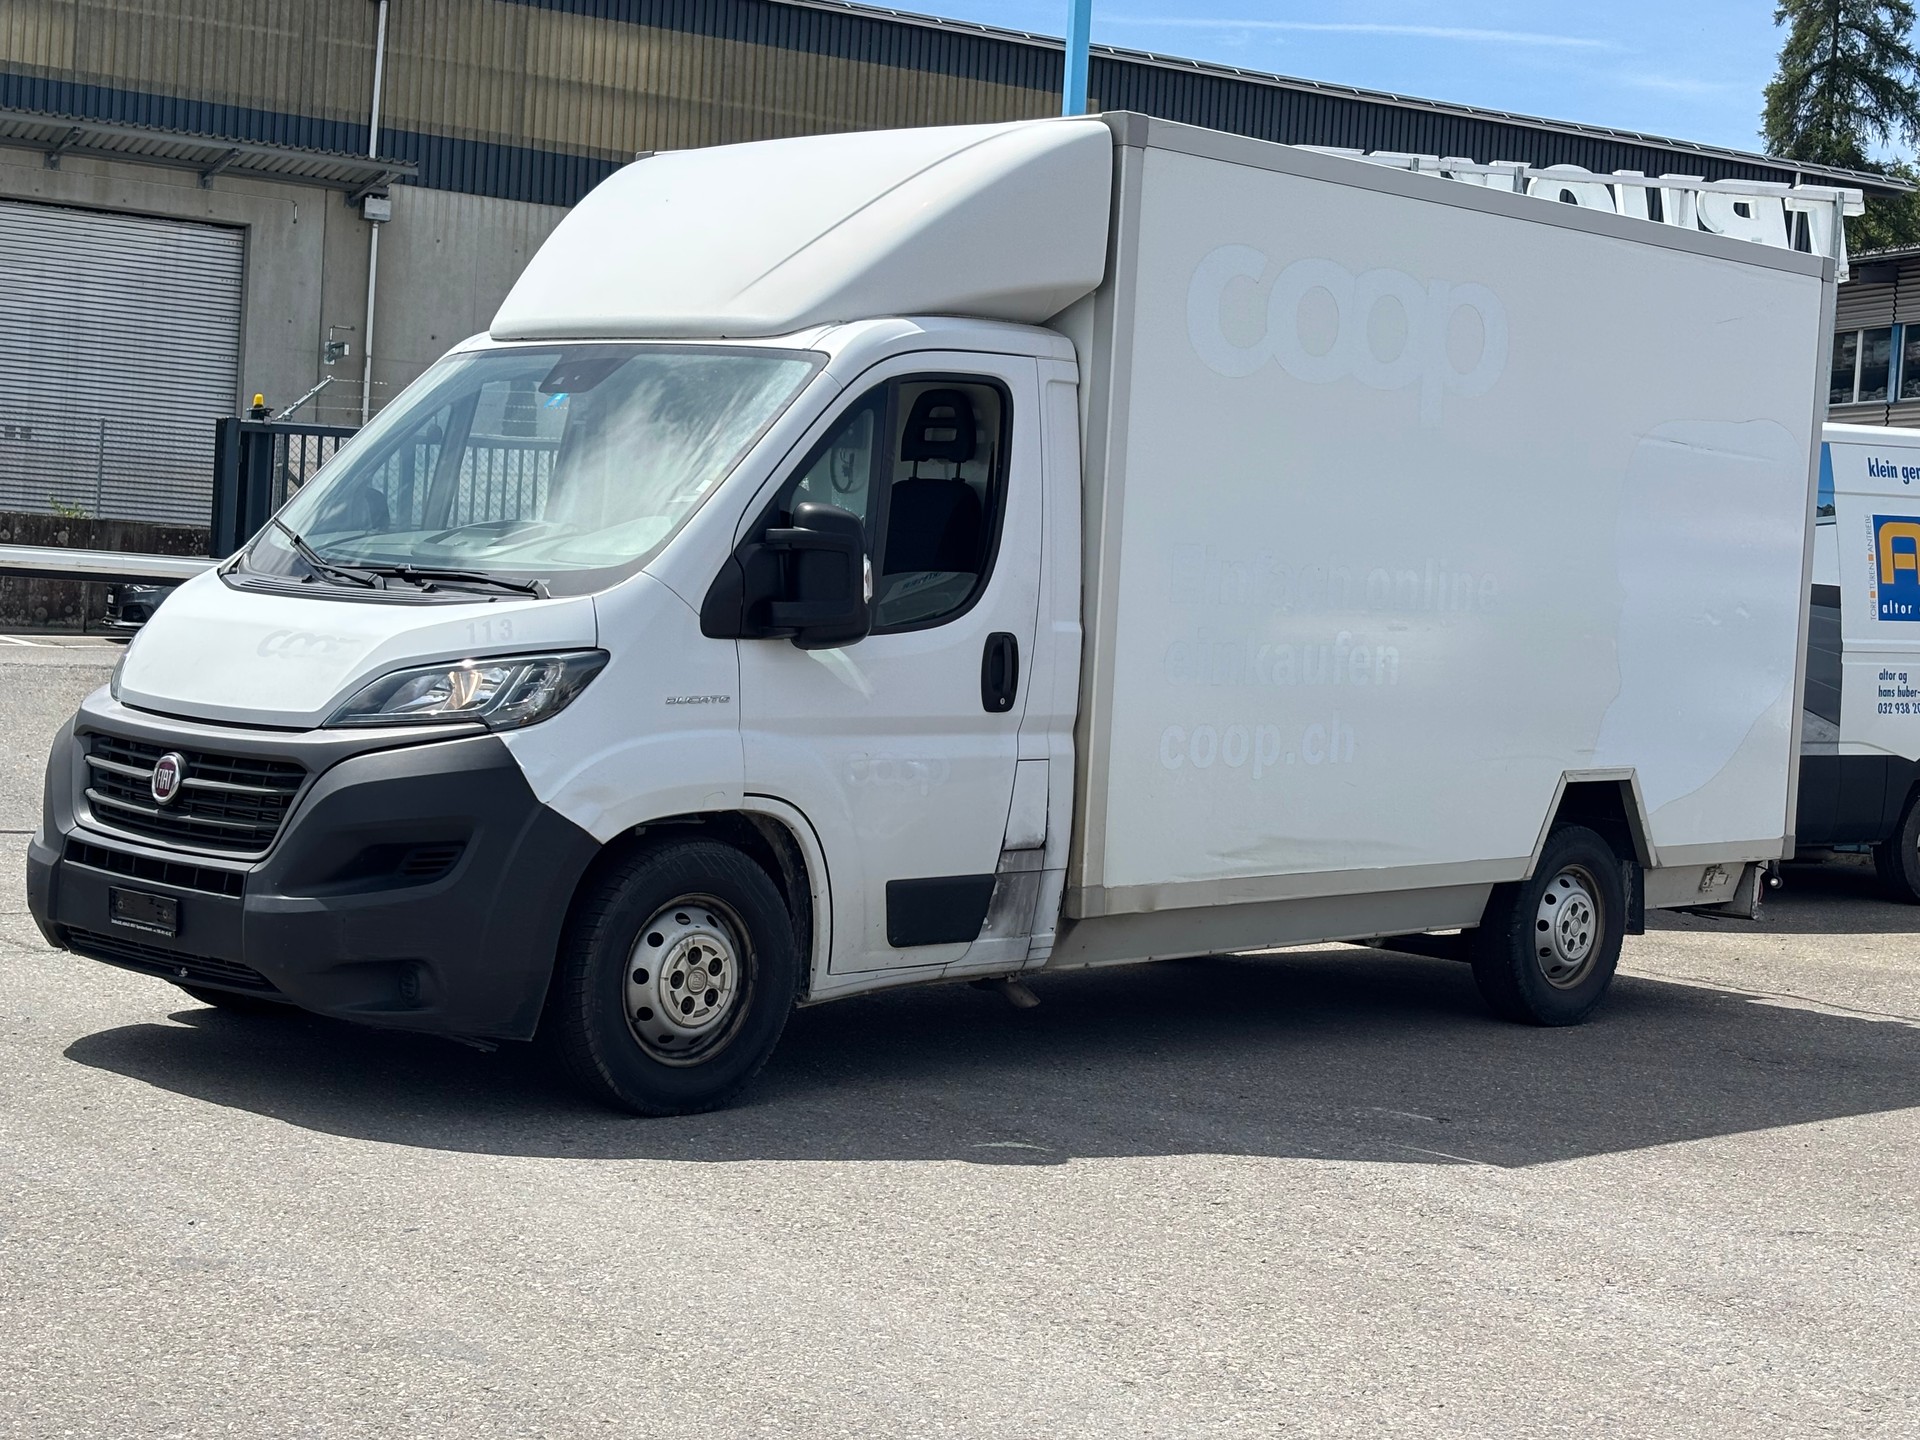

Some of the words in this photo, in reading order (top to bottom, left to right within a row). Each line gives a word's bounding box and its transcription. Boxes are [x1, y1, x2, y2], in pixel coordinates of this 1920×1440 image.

[1185, 242, 1509, 428] coop
[1867, 457, 1898, 478] klein
[1365, 557, 1500, 613] online
[1882, 600, 1912, 614] altor
[466, 618, 514, 645] 113
[1163, 626, 1400, 687] einkaufen
[1879, 668, 1897, 681] altor
[1898, 672, 1908, 684] ag
[665, 695, 730, 705] DUCATO
[1878, 685, 1896, 697] hans
[1878, 702, 1893, 714] 032
[1895, 702, 1910, 714] 938
[1159, 709, 1356, 780] coop.ch
[157, 768, 174, 790] FIAT
